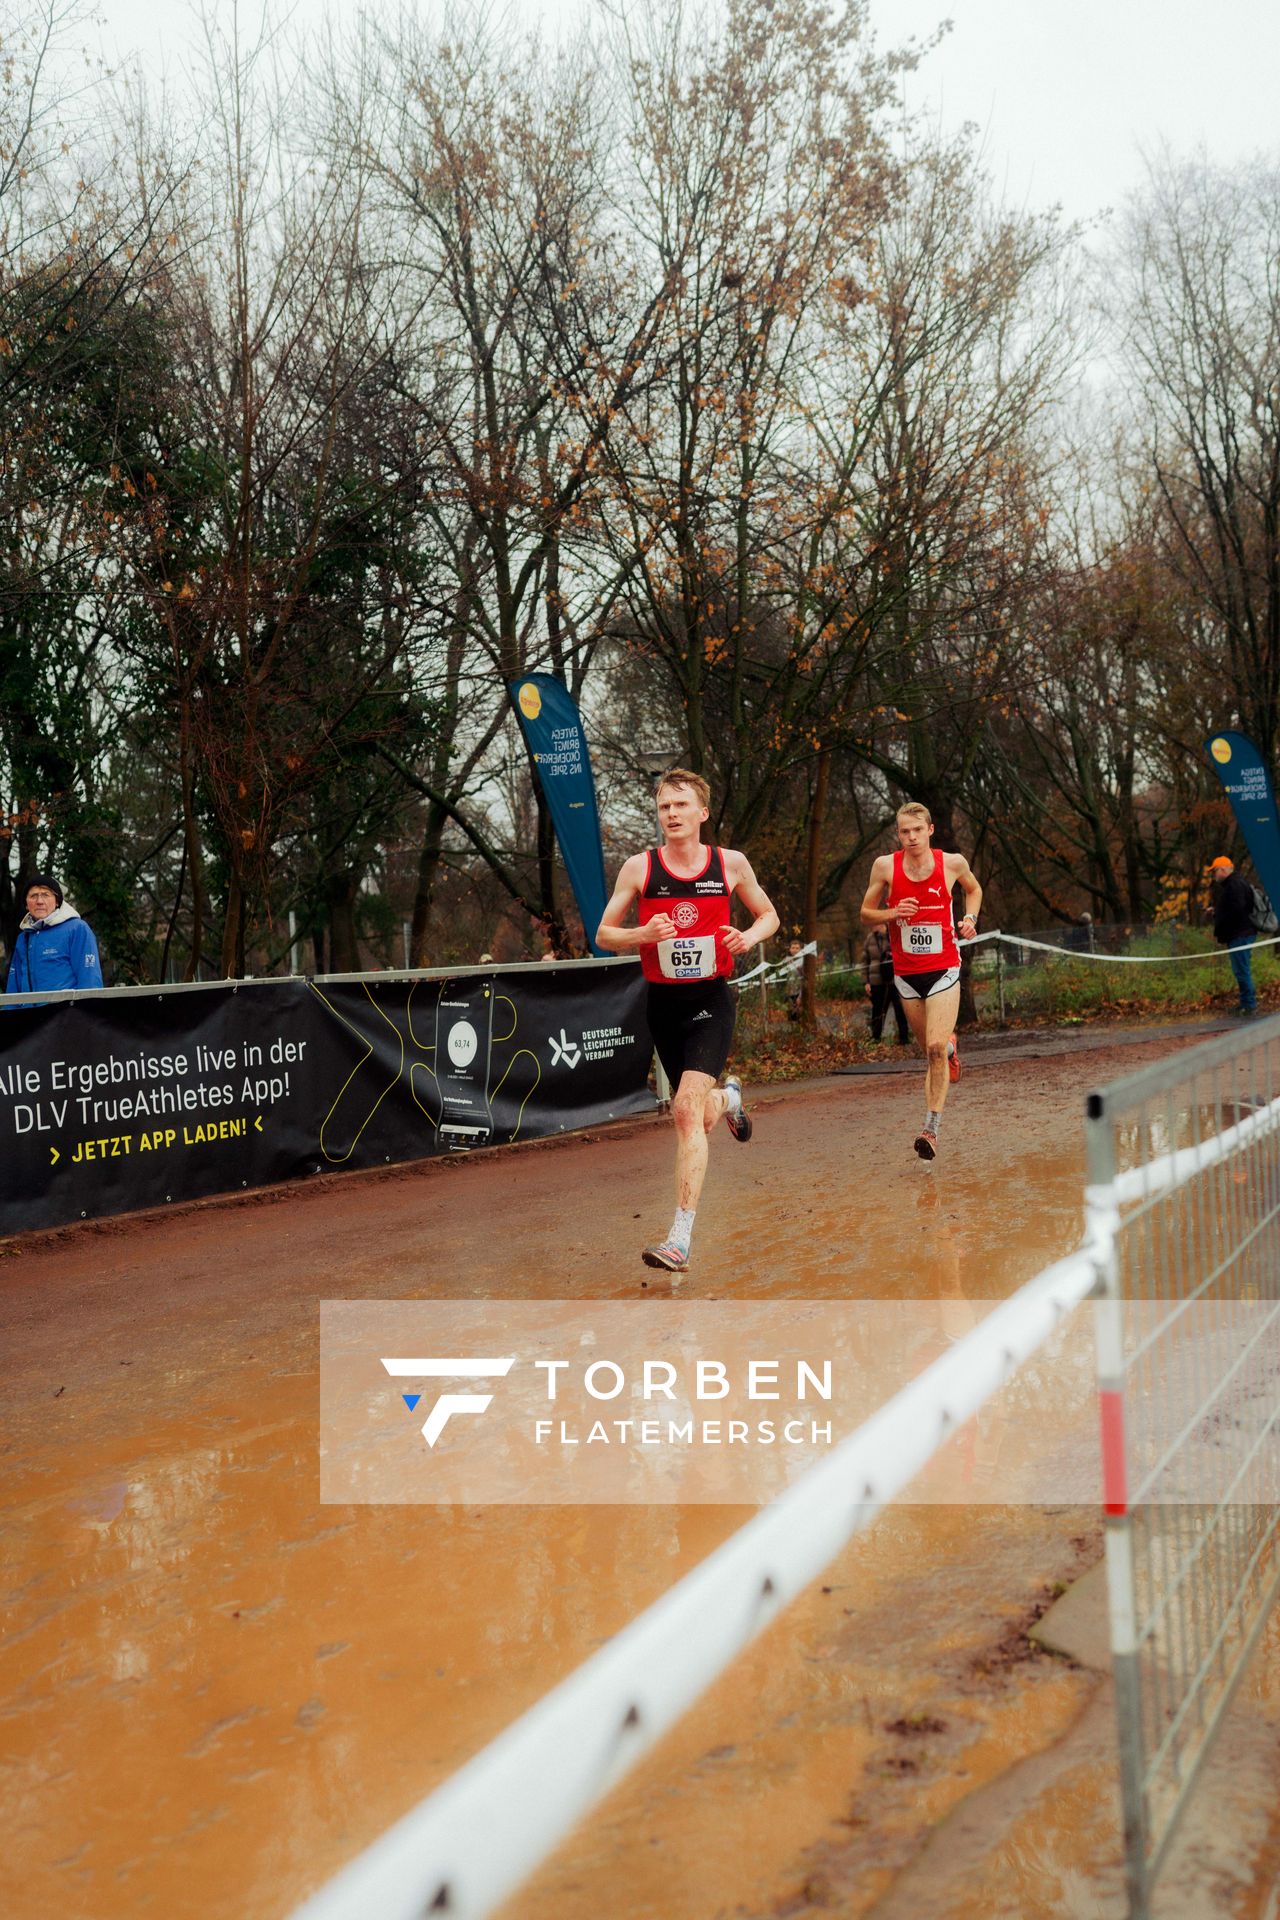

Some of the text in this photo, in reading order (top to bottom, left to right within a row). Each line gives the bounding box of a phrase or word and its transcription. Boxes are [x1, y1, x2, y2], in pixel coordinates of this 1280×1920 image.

[674, 940, 695, 949] GLS
[910, 934, 932, 945] 600
[671, 950, 702, 966] 657
[582, 1027, 622, 1040] DEUTSCHER
[454, 1040, 470, 1049] 63,74
[583, 1035, 635, 1051] LEICHTATHLETIK
[585, 1049, 614, 1061] VERBAND
[51, 1051, 188, 1093] Ergebnisse
[196, 1046, 237, 1072] live
[243, 1041, 262, 1067] in
[270, 1038, 307, 1064] der
[14, 1072, 290, 1134] DLV TrueAthletes App!
[72, 1118, 247, 1163] JETZT APP LADEN!
